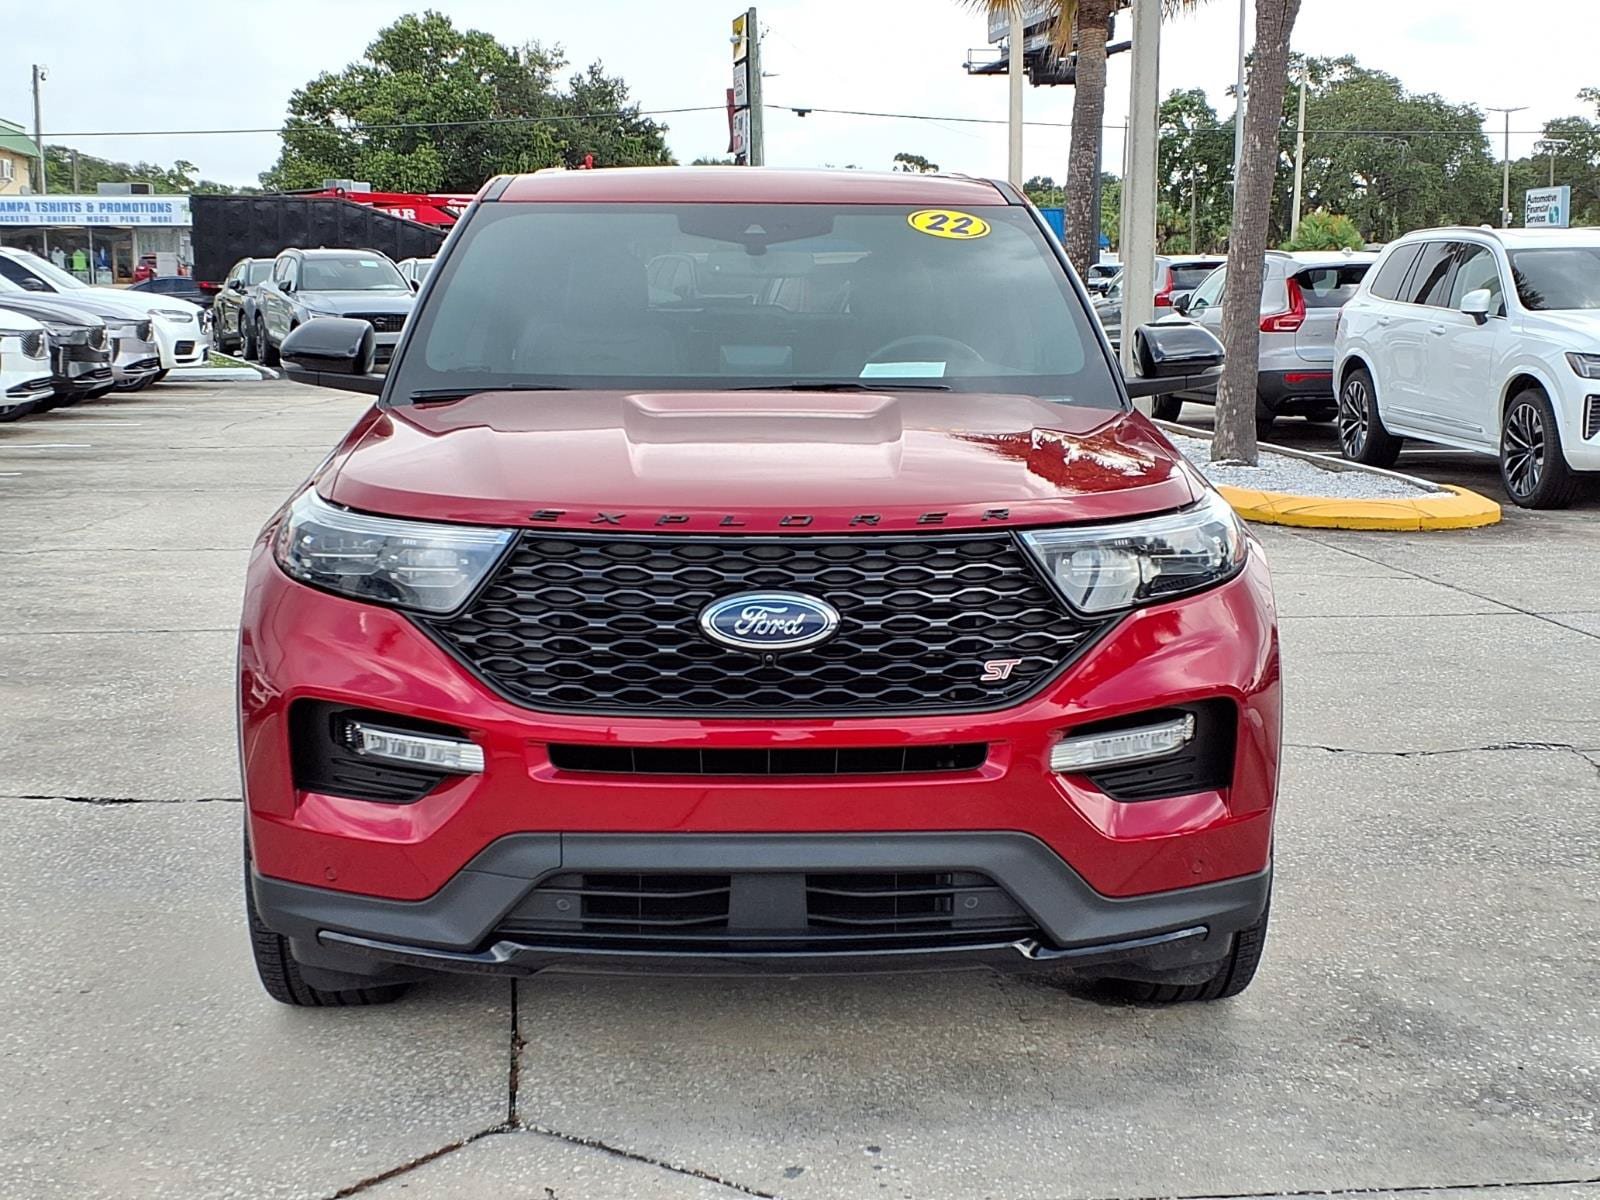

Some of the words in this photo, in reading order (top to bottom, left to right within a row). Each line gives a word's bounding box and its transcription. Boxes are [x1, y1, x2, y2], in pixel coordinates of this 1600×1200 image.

[35, 202, 82, 212] TSHIRTS
[86, 202, 94, 212] &
[99, 202, 173, 212] PROMOTIONS
[926, 213, 974, 235] 22
[1526, 214, 1546, 223] Services
[529, 508, 1009, 526] EXPLORER
[734, 605, 806, 635] Ford
[980, 658, 1022, 681] ST
